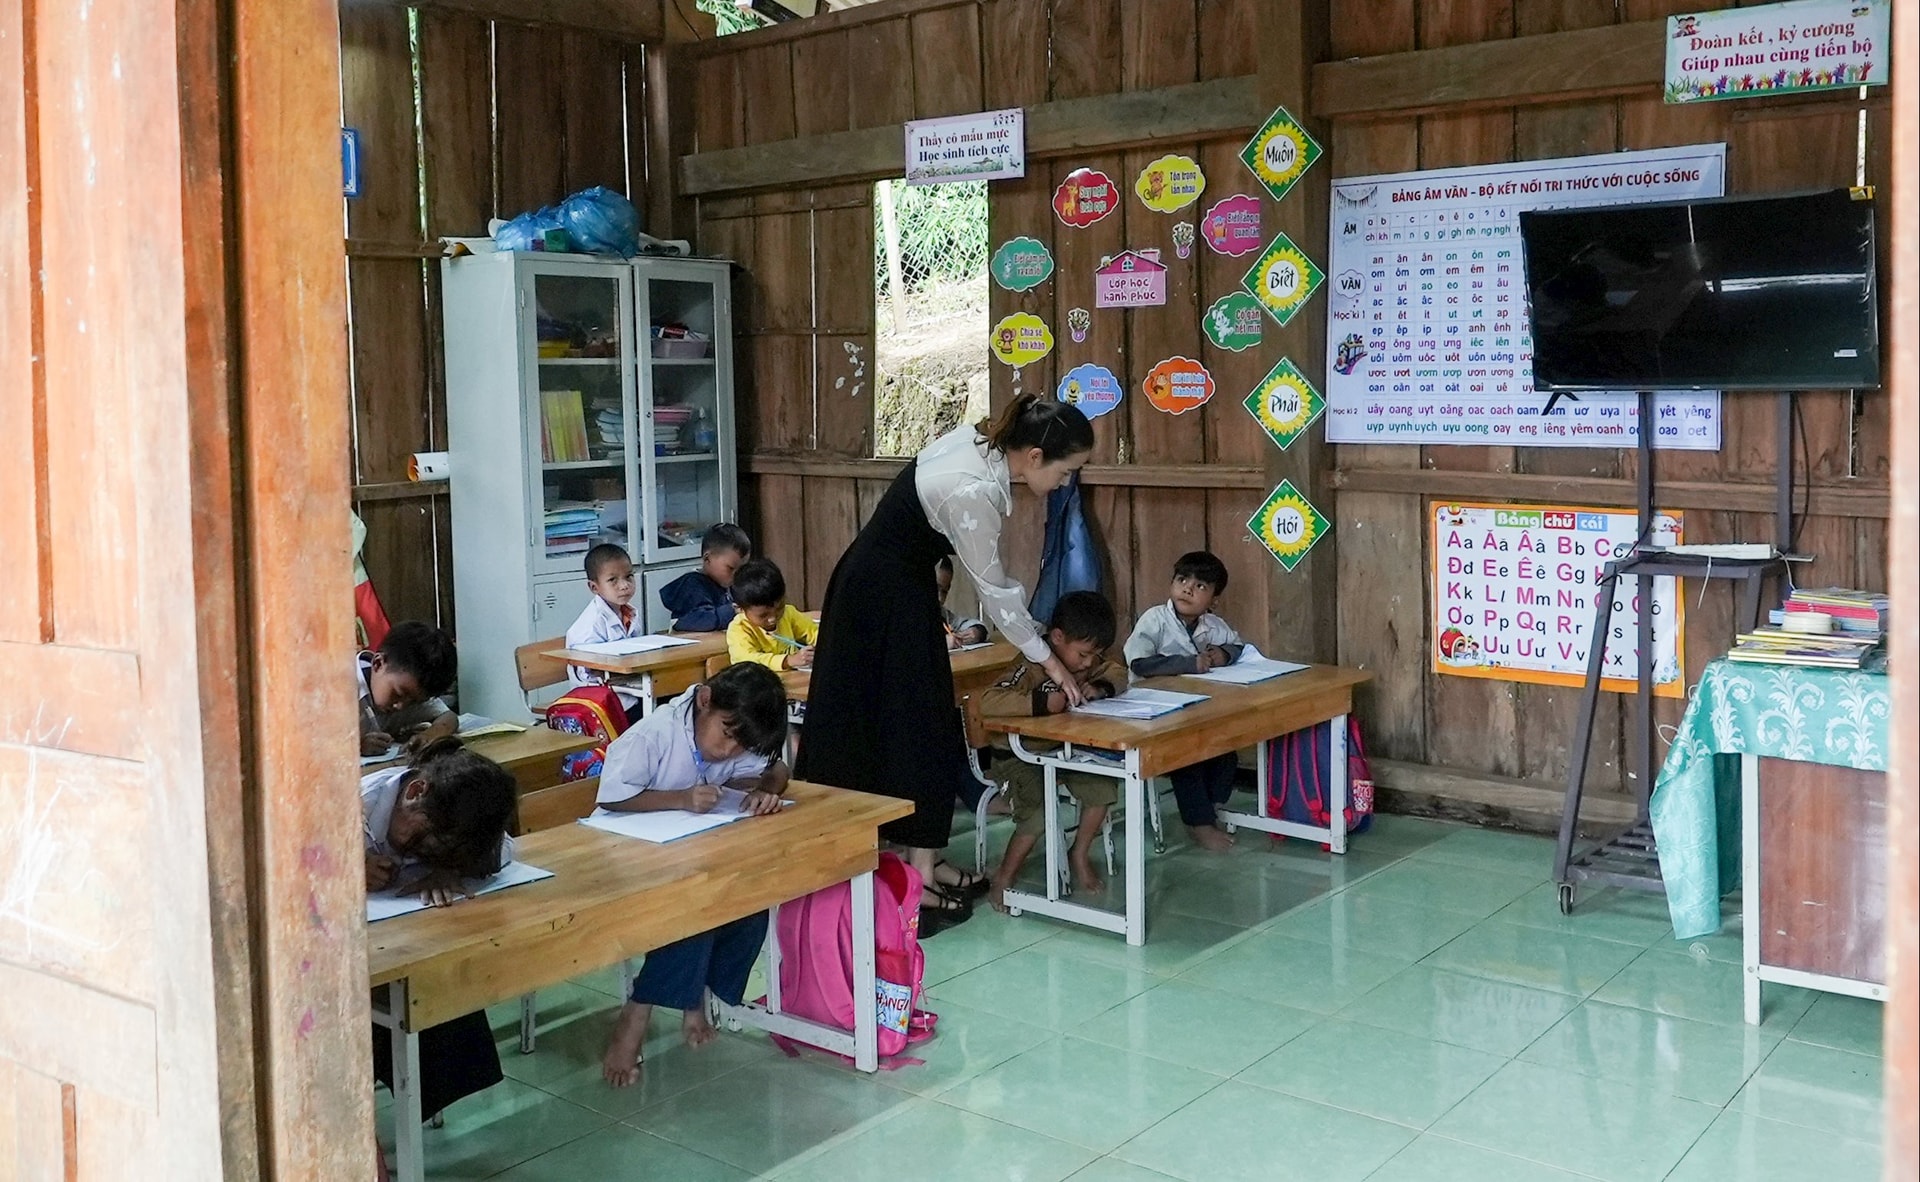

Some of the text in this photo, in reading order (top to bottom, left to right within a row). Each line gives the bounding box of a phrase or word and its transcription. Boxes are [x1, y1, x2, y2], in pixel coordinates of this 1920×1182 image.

[1690, 35, 1733, 51] Đoàn
[1739, 26, 1763, 46] kết
[1802, 22, 1855, 40] cương
[1681, 37, 1873, 73] Giúp nhau cùng tiến bộ
[919, 144, 1010, 164] Học sinh tích cực
[1266, 141, 1294, 165] Muốn
[1392, 168, 1699, 202] BẢNG ÂM VẦN BỘ KẾT NỐI TRI THỨC VỚI CUỘC SỐNG
[1343, 222, 1356, 235] ÂM
[1270, 266, 1294, 289] Biết
[1334, 311, 1350, 320] Học
[1270, 394, 1298, 413] Phải
[1389, 407, 1413, 416] oang
[1418, 405, 1434, 416] uyt
[1468, 407, 1485, 415] oac
[1491, 405, 1513, 415] oach
[1517, 407, 1538, 415] oam
[1575, 407, 1589, 415] uơ
[1601, 407, 1619, 418] uya
[1660, 405, 1676, 418] yêt
[1684, 405, 1711, 419] yêng
[1367, 422, 1706, 436] uyp uynh uych uyu oong oay eng iêng yêm oanh oao oet
[1277, 516, 1298, 534] Hỏi
[1497, 512, 1604, 530] Bảng chữ cái
